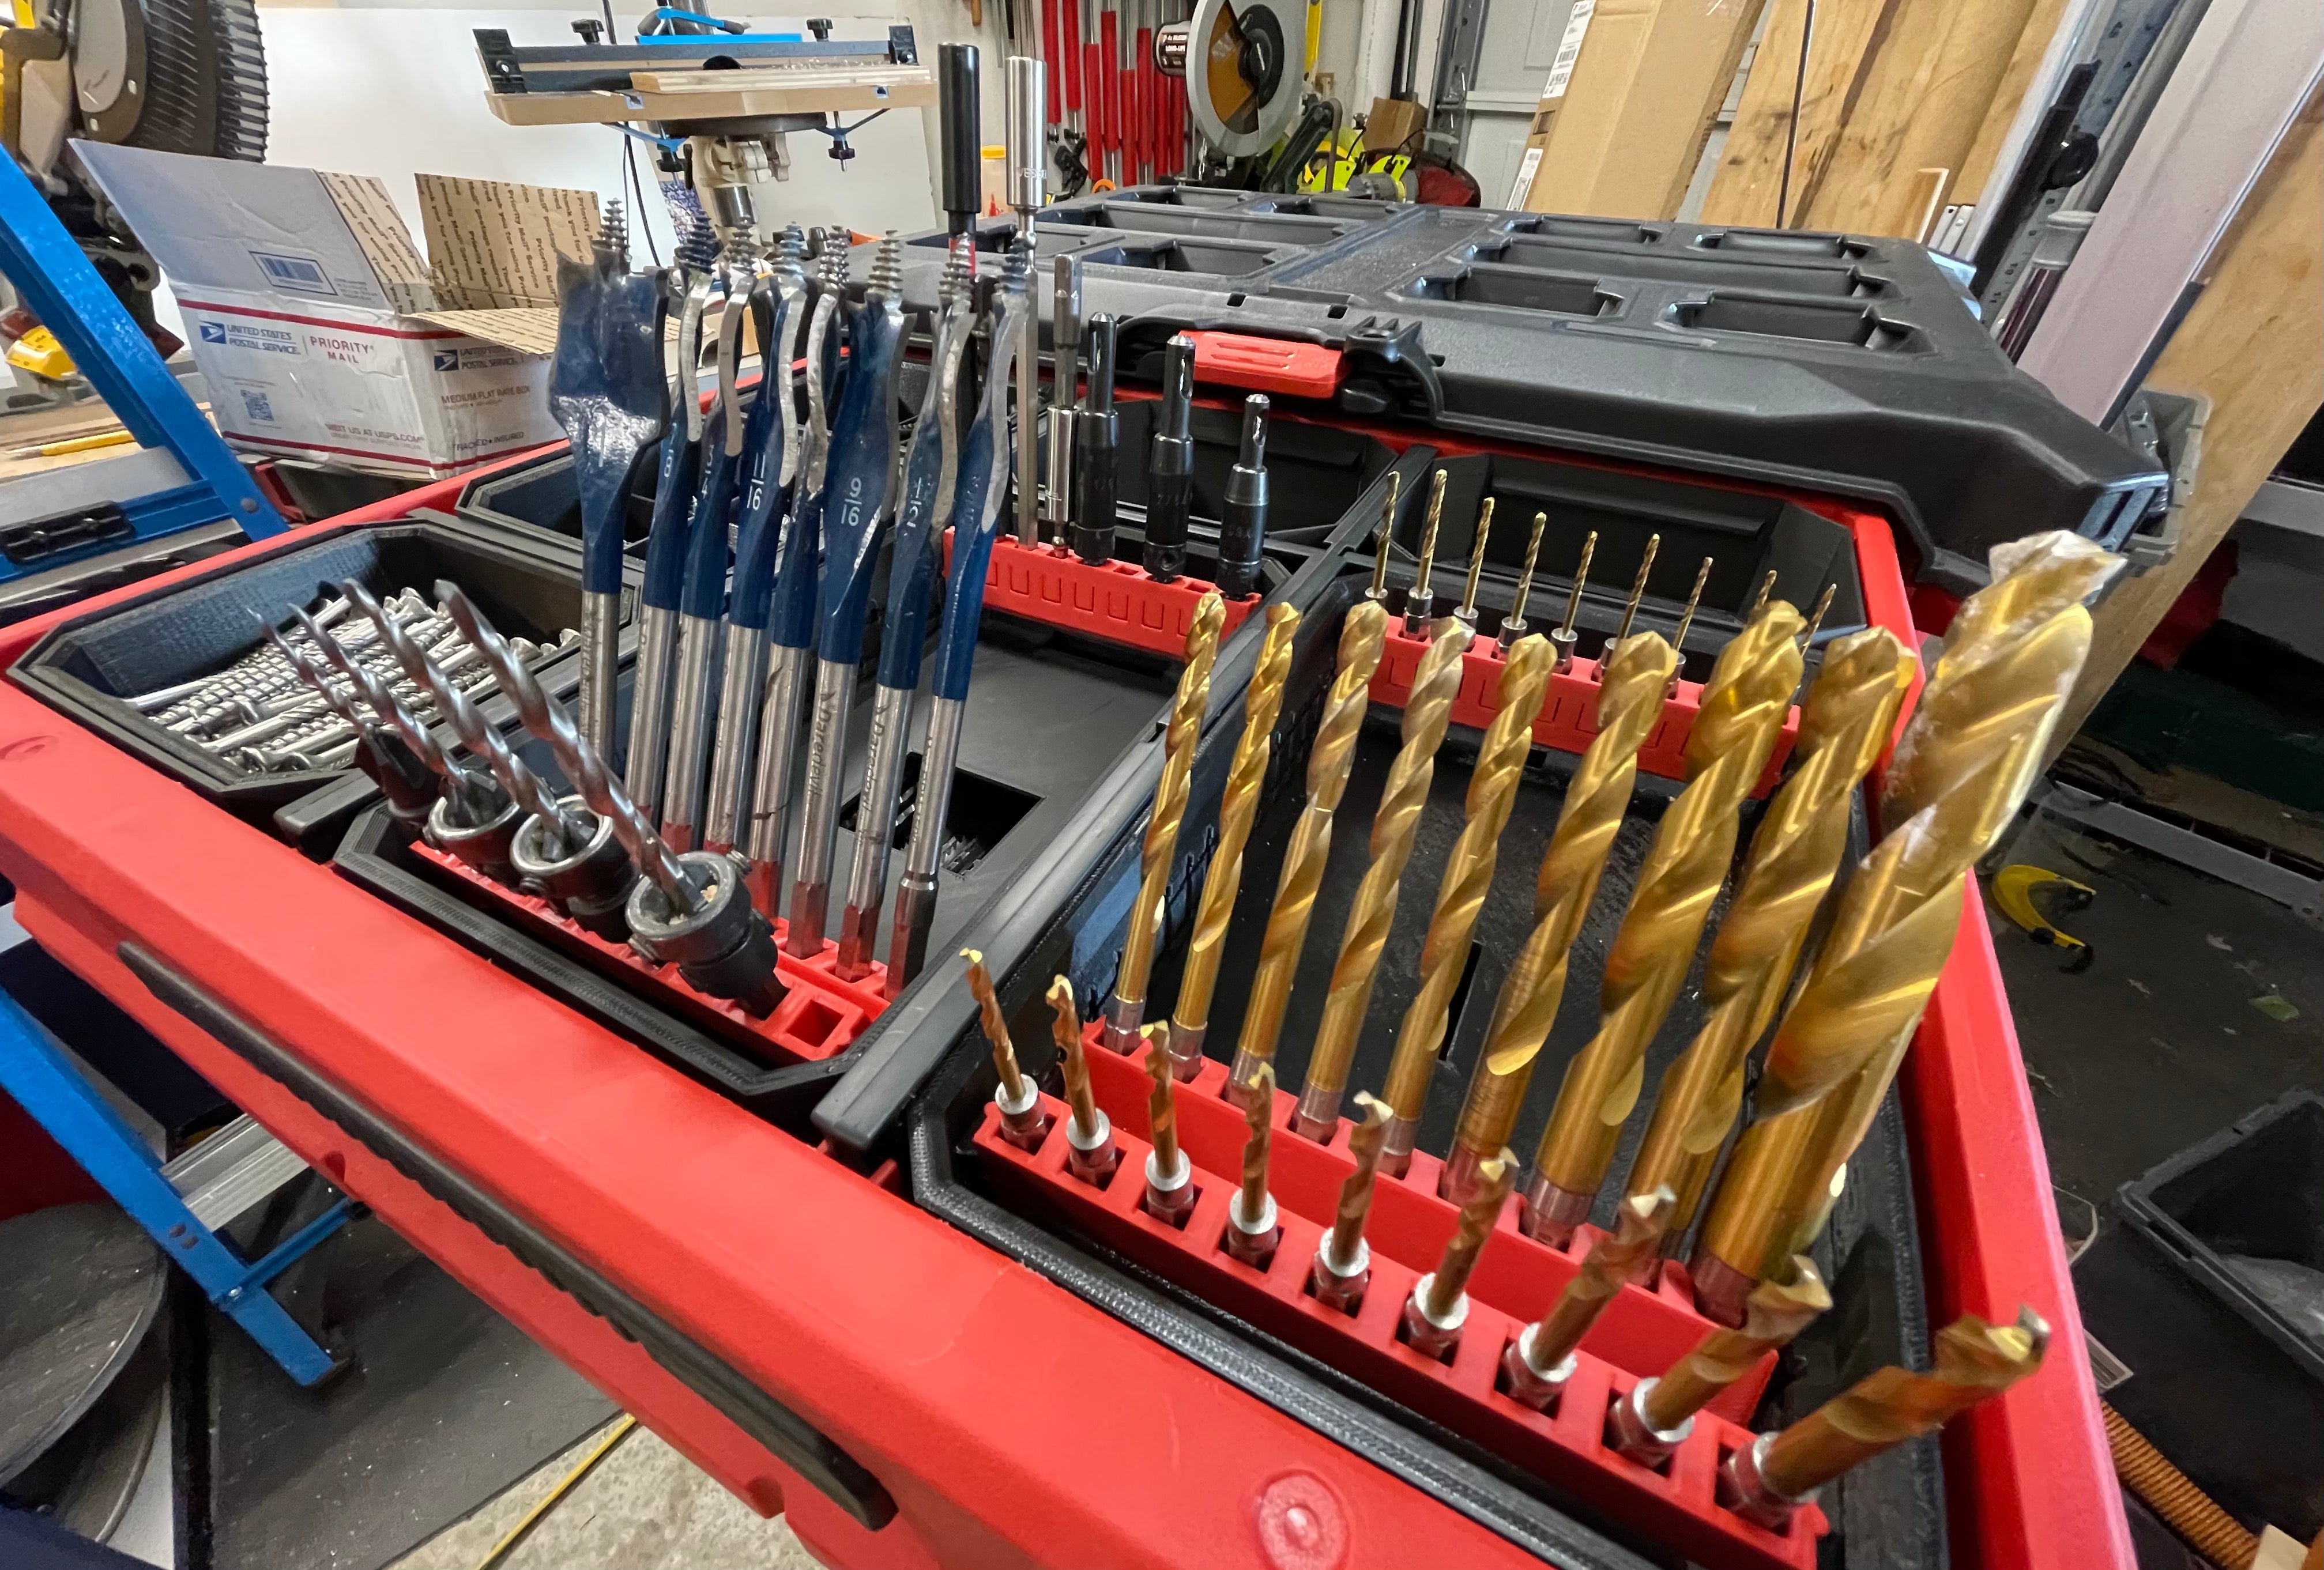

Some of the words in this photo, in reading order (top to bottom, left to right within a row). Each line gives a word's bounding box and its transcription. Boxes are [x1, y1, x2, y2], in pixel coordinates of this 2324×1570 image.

[340, 180, 368, 214] Priority
[577, 197, 590, 232] Priority
[389, 227, 416, 258] Priority
[469, 231, 481, 265] Priority
[508, 189, 521, 224] Priority
[526, 255, 539, 288] Service
[567, 220, 578, 236] you
[574, 240, 582, 253] for
[510, 248, 521, 273] using
[536, 238, 549, 271] Priority
[488, 248, 503, 287] required
[227, 324, 258, 336] UNITED
[261, 329, 292, 341] STATES
[228, 339, 260, 350] POSTAL
[327, 351, 359, 364] MAIL
[441, 392, 476, 404] MEDIUM
[478, 390, 496, 400] FLAT
[497, 387, 514, 397] RATE
[516, 385, 530, 394] BOX
[348, 427, 361, 435] US
[363, 428, 374, 436] AT
[494, 432, 525, 443] INSURED
[747, 485, 763, 510] 16
[849, 477, 862, 497] 9
[841, 504, 860, 526] 16
[809, 709, 831, 796] Daredevil
